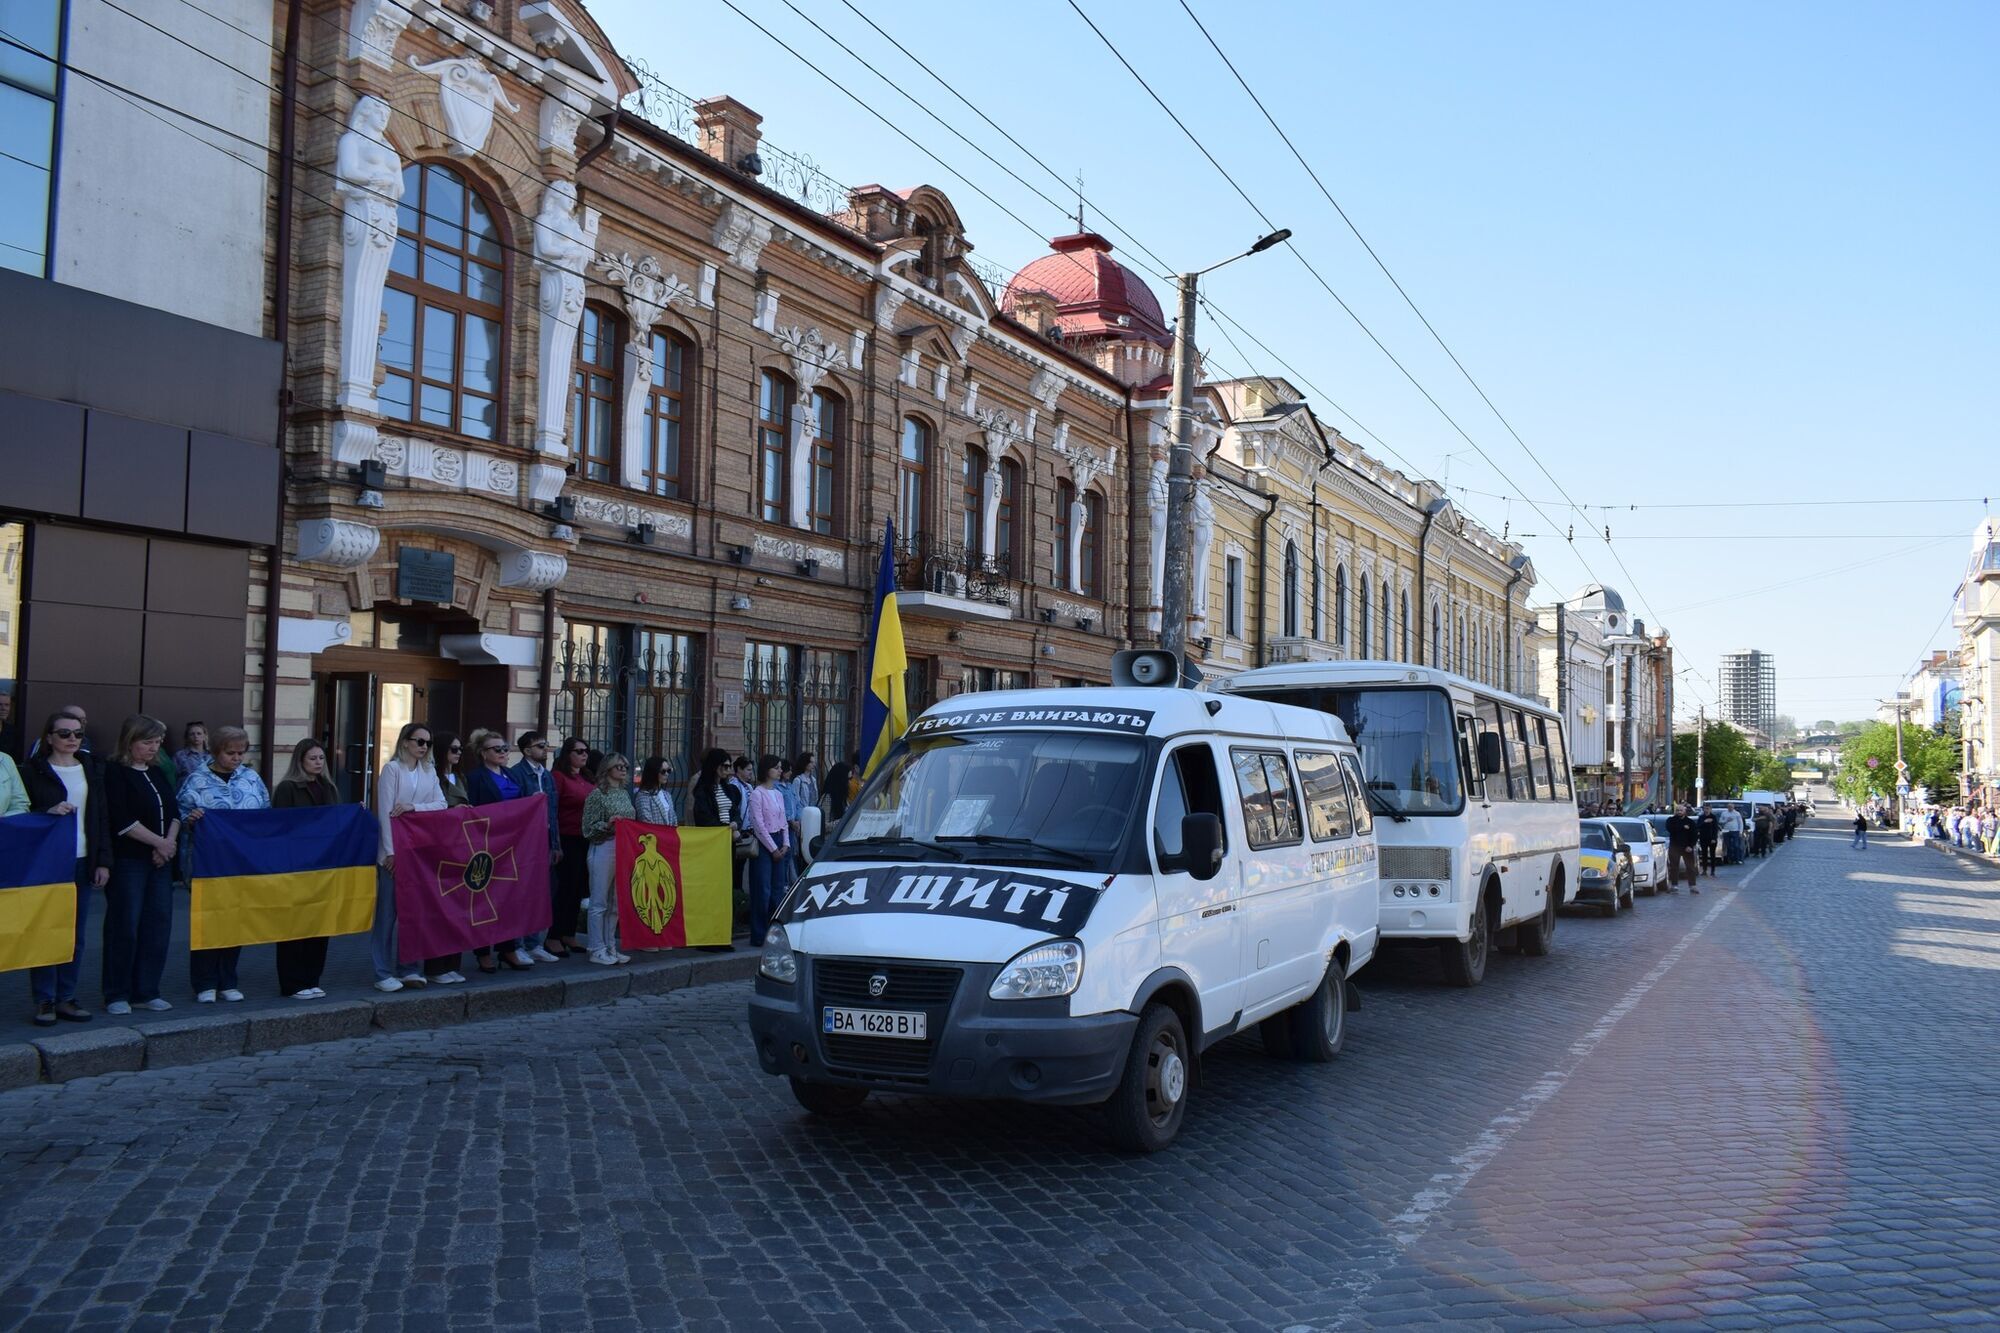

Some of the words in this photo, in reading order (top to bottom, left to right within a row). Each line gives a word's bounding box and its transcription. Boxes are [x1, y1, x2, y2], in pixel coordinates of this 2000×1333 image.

[1010, 710, 1147, 728] ВМИРАЮТЬ
[888, 875, 1072, 923] ЩИТІ
[860, 1014, 894, 1032] 1628
